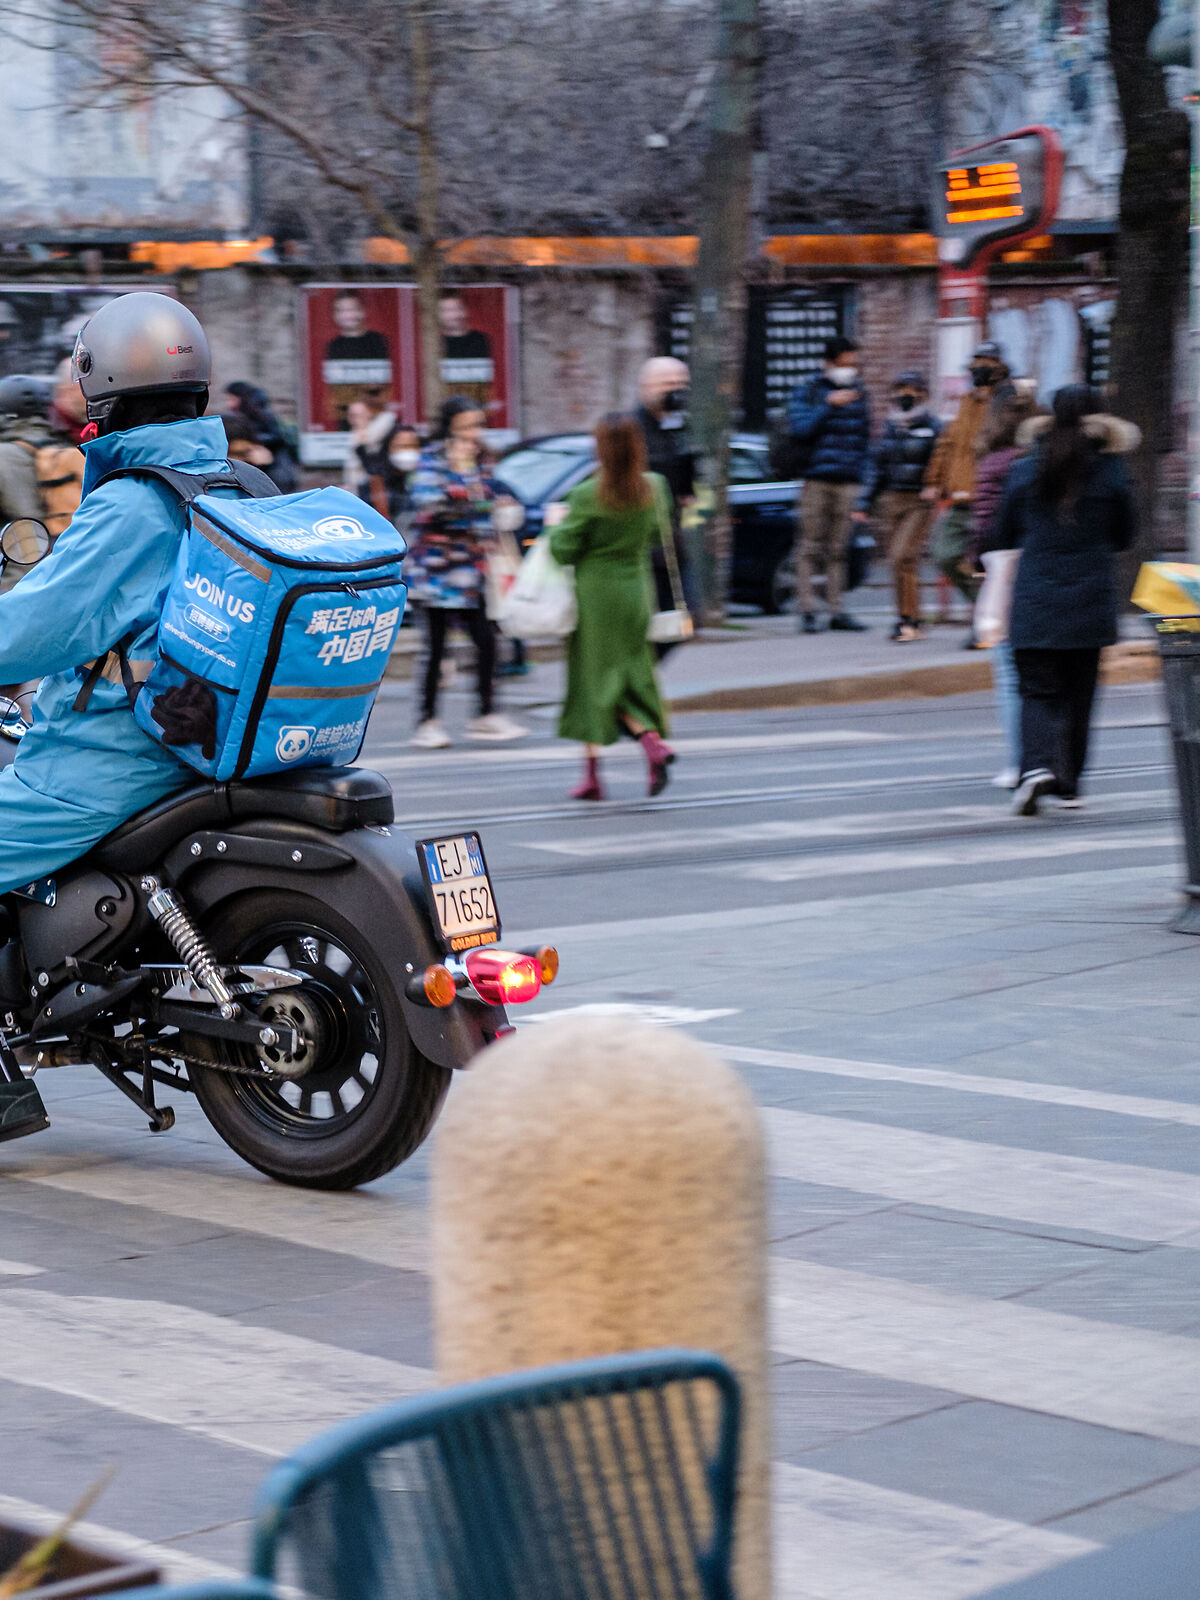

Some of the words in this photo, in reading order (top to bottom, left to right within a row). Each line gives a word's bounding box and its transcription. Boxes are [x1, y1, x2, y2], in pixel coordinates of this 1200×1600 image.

[184, 573, 225, 608] JOIN
[227, 595, 256, 623] US
[437, 842, 462, 877] EJ
[437, 886, 494, 927] 71652
